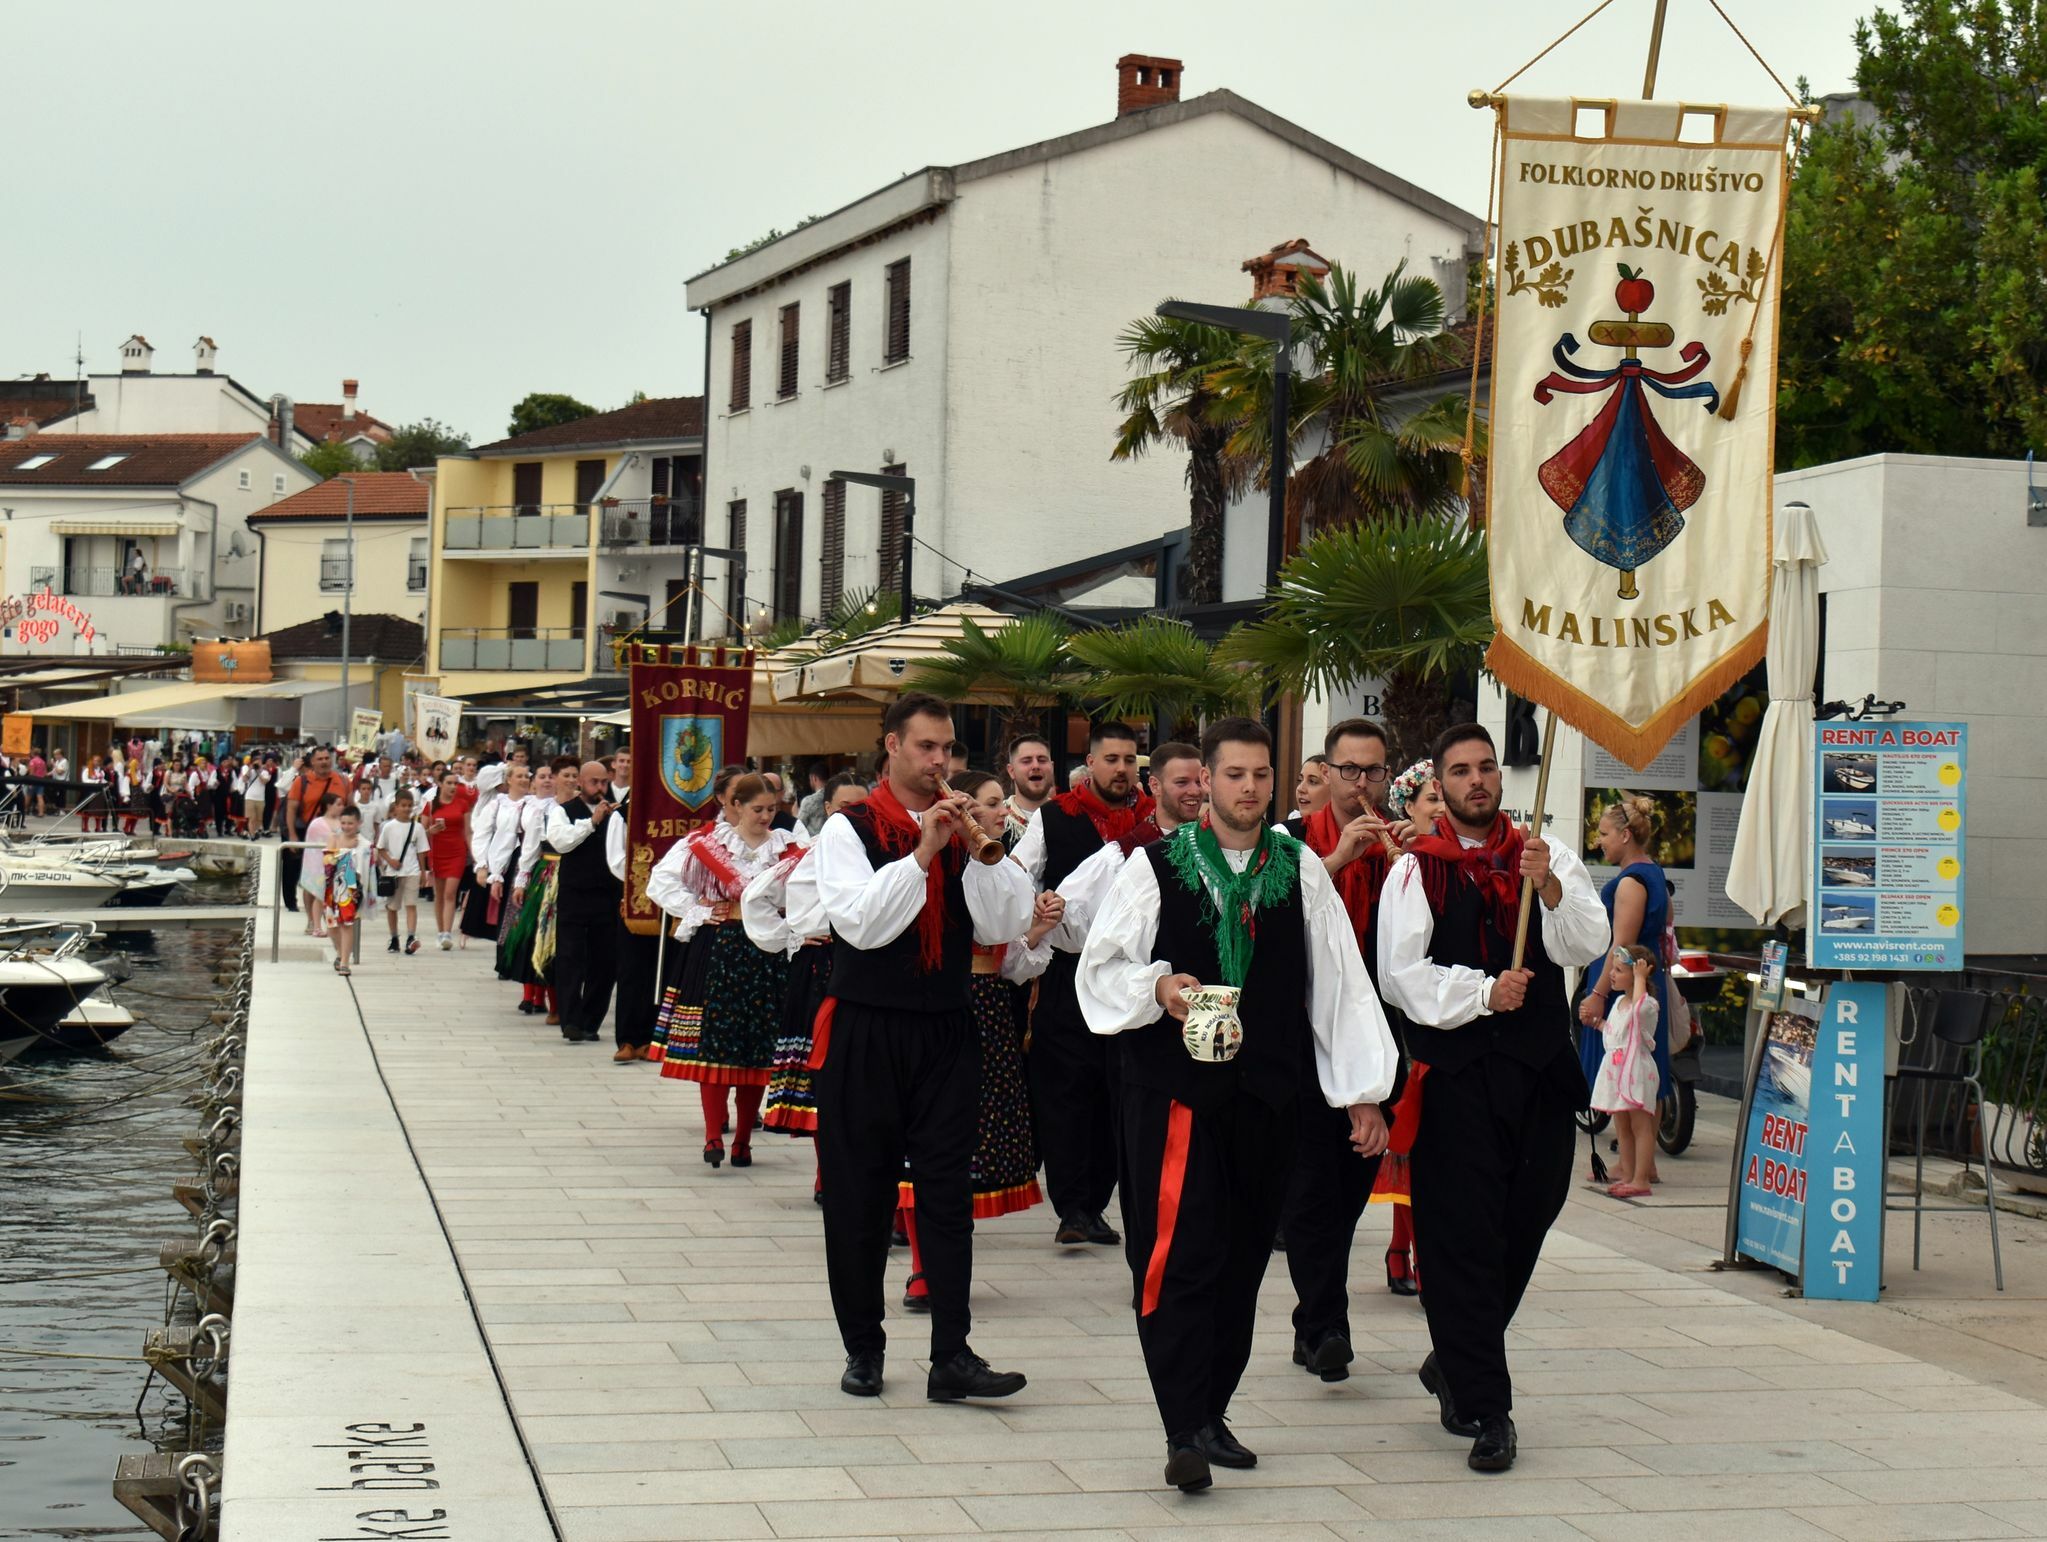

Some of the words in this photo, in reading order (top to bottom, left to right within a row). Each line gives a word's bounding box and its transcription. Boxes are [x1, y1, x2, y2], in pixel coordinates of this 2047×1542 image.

[1520, 162, 1655, 191] FOLKLORNO
[1660, 166, 1764, 193] DRUŠTVO
[1523, 206, 1741, 277] DUBAŠNICA
[18, 619, 59, 644] gogo
[27, 585, 96, 644] gelateria
[1520, 598, 1736, 648] MALINSKA
[641, 678, 744, 711] KORNIĆ
[1822, 729, 1877, 746] RENT
[1880, 730, 1896, 746] A
[1902, 730, 1961, 746] BOAT
[1833, 940, 1945, 951] www.navisrent.com
[1833, 953, 1856, 962] +385
[1857, 953, 1870, 962] 92
[1872, 953, 1888, 962] 198
[1890, 954, 1909, 962] 1431
[1834, 1000, 1859, 1118] RENT
[1760, 1112, 1808, 1157] RENT
[1833, 1130, 1856, 1155] A
[1745, 1153, 1760, 1188] A
[1762, 1157, 1807, 1205] BOAT
[1830, 1167, 1857, 1285] BOAT
